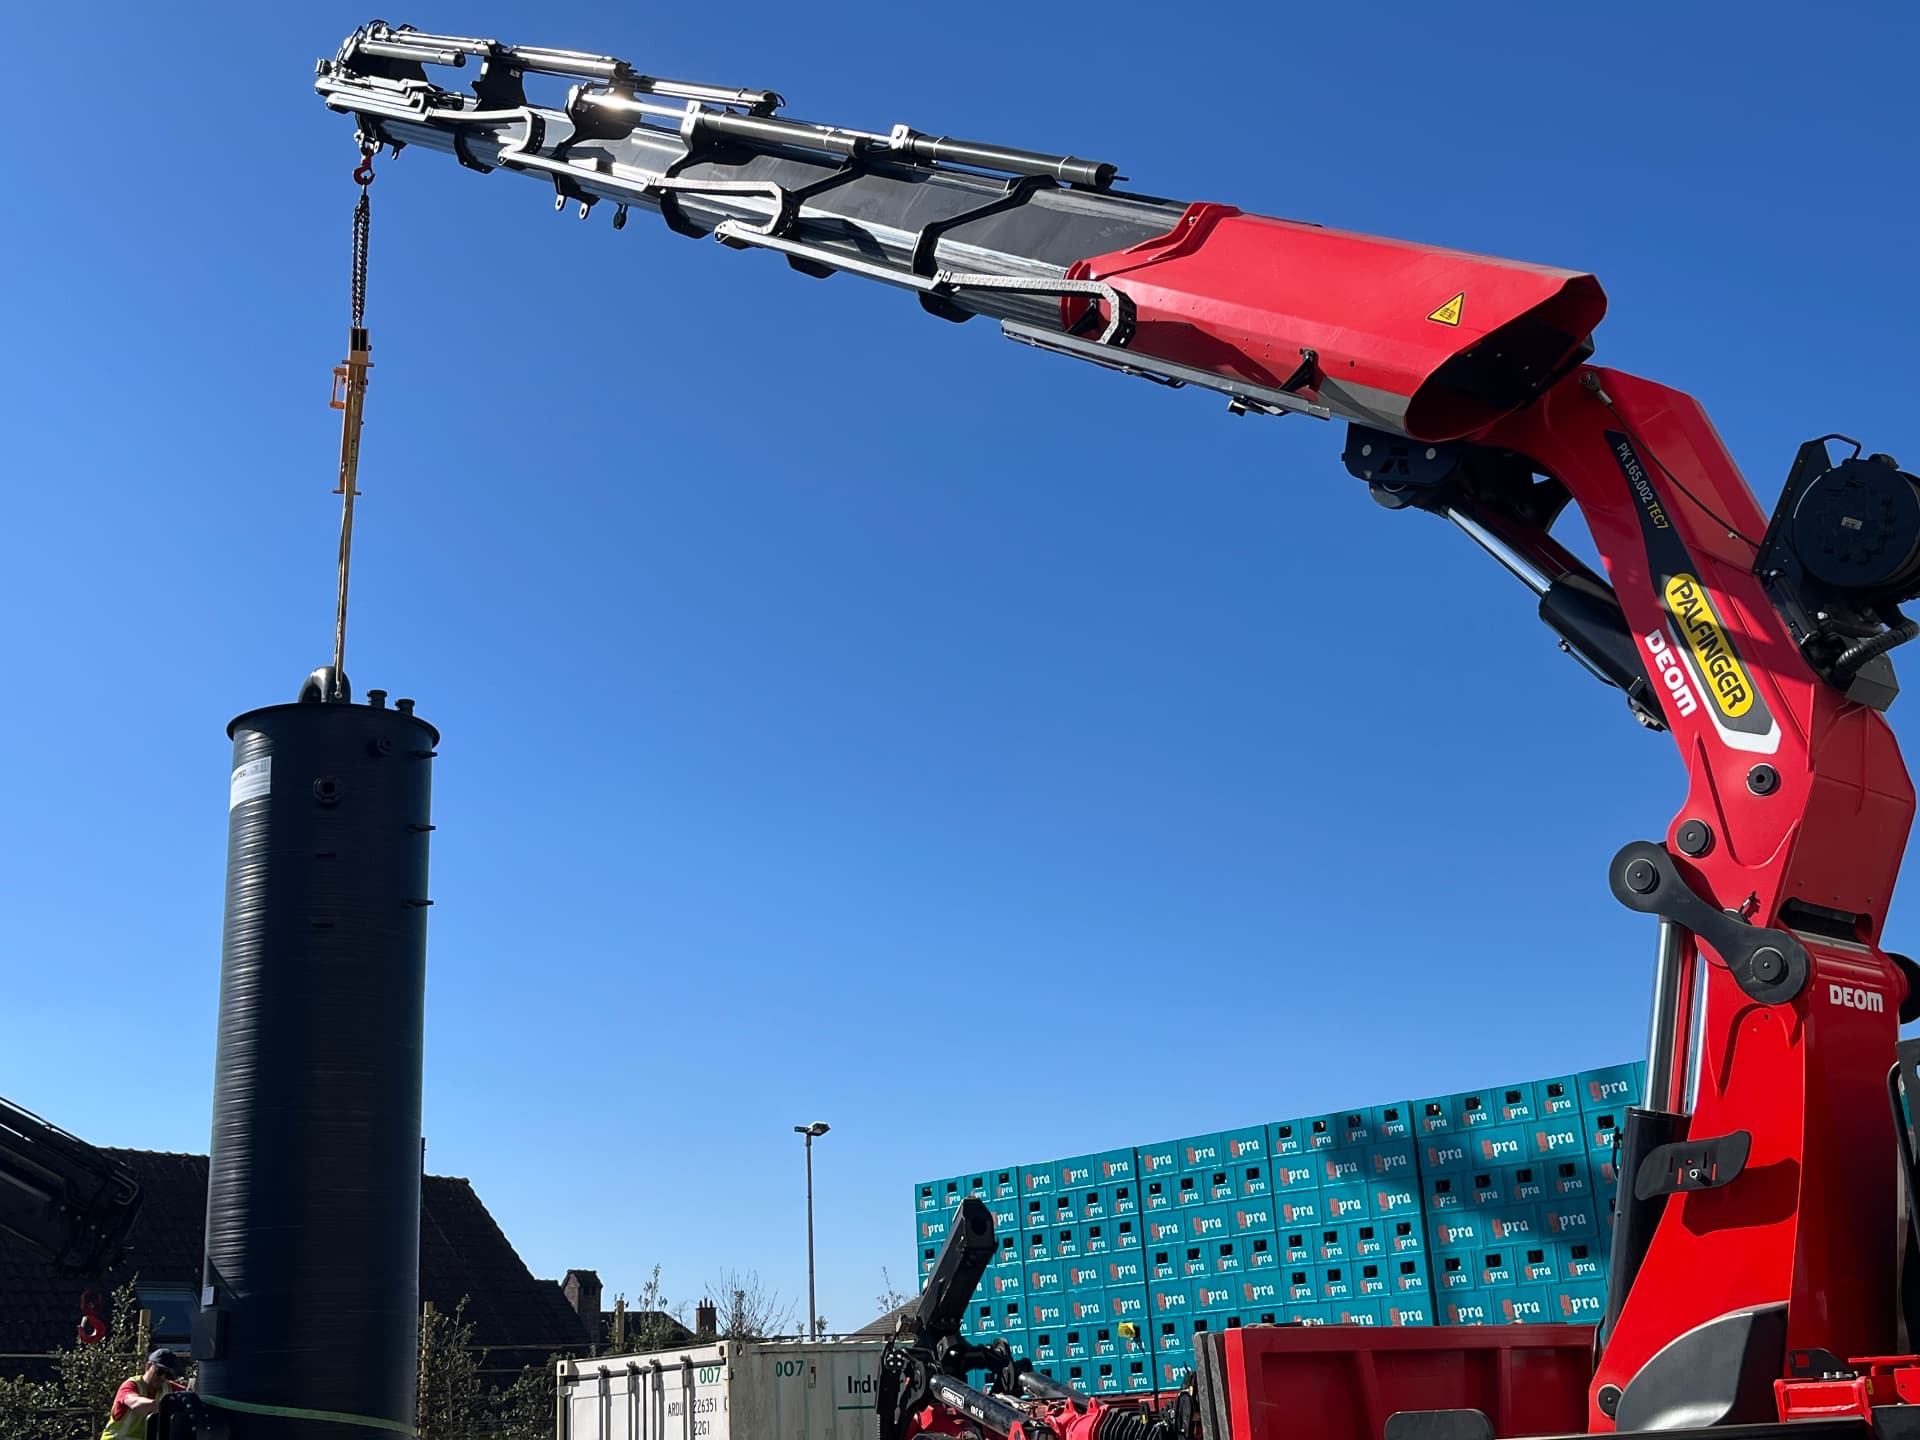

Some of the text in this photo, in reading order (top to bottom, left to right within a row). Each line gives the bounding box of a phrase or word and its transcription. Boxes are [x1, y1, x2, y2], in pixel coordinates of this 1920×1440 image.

[1617, 443, 1669, 528] PK 165.002 TEC7
[1671, 580, 1746, 710] PALFINGER
[1645, 629, 1697, 717] DEOM
[1829, 984, 1884, 1012] DEOM
[699, 1366, 721, 1384] 007
[776, 1360, 804, 1377] 007
[848, 1375, 876, 1393] Ind
